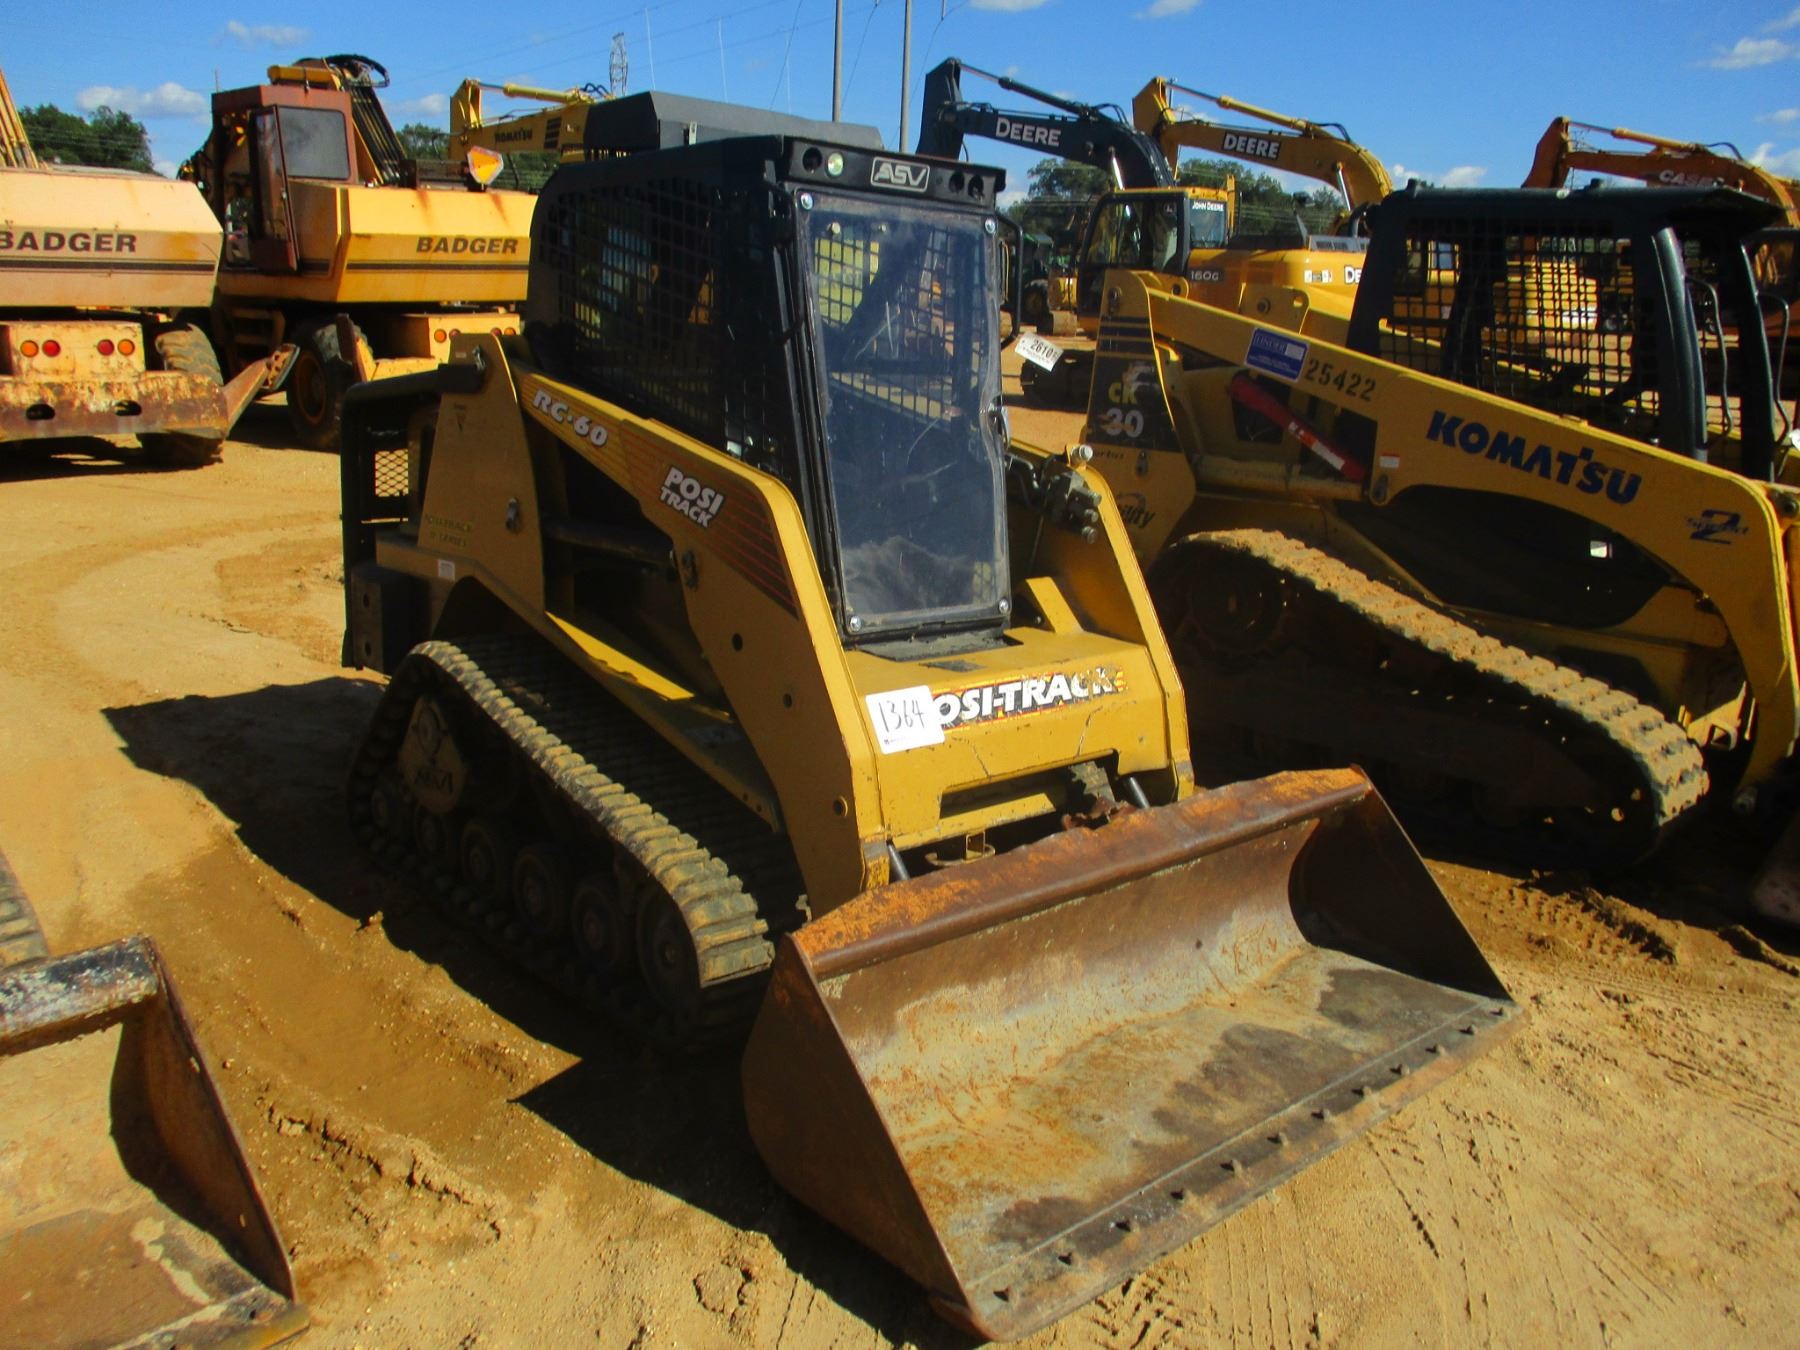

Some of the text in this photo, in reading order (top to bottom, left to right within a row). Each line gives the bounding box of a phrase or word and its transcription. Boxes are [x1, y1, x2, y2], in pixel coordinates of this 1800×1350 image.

[995, 116, 1062, 148] DEERE
[1223, 132, 1280, 159] DEERE
[873, 162, 928, 187] ASV
[1191, 201, 1225, 212] JOHN DEERE
[0, 230, 137, 253] BADGER
[416, 236, 518, 254] BADGER
[1304, 357, 1377, 402] 25422
[1104, 407, 1145, 438] 30
[1426, 410, 1642, 505] KOMATSU
[660, 486, 713, 528] TRACK
[664, 466, 725, 516] POSI
[932, 667, 1114, 726] OSI-TRACK
[878, 700, 926, 733] 1364
